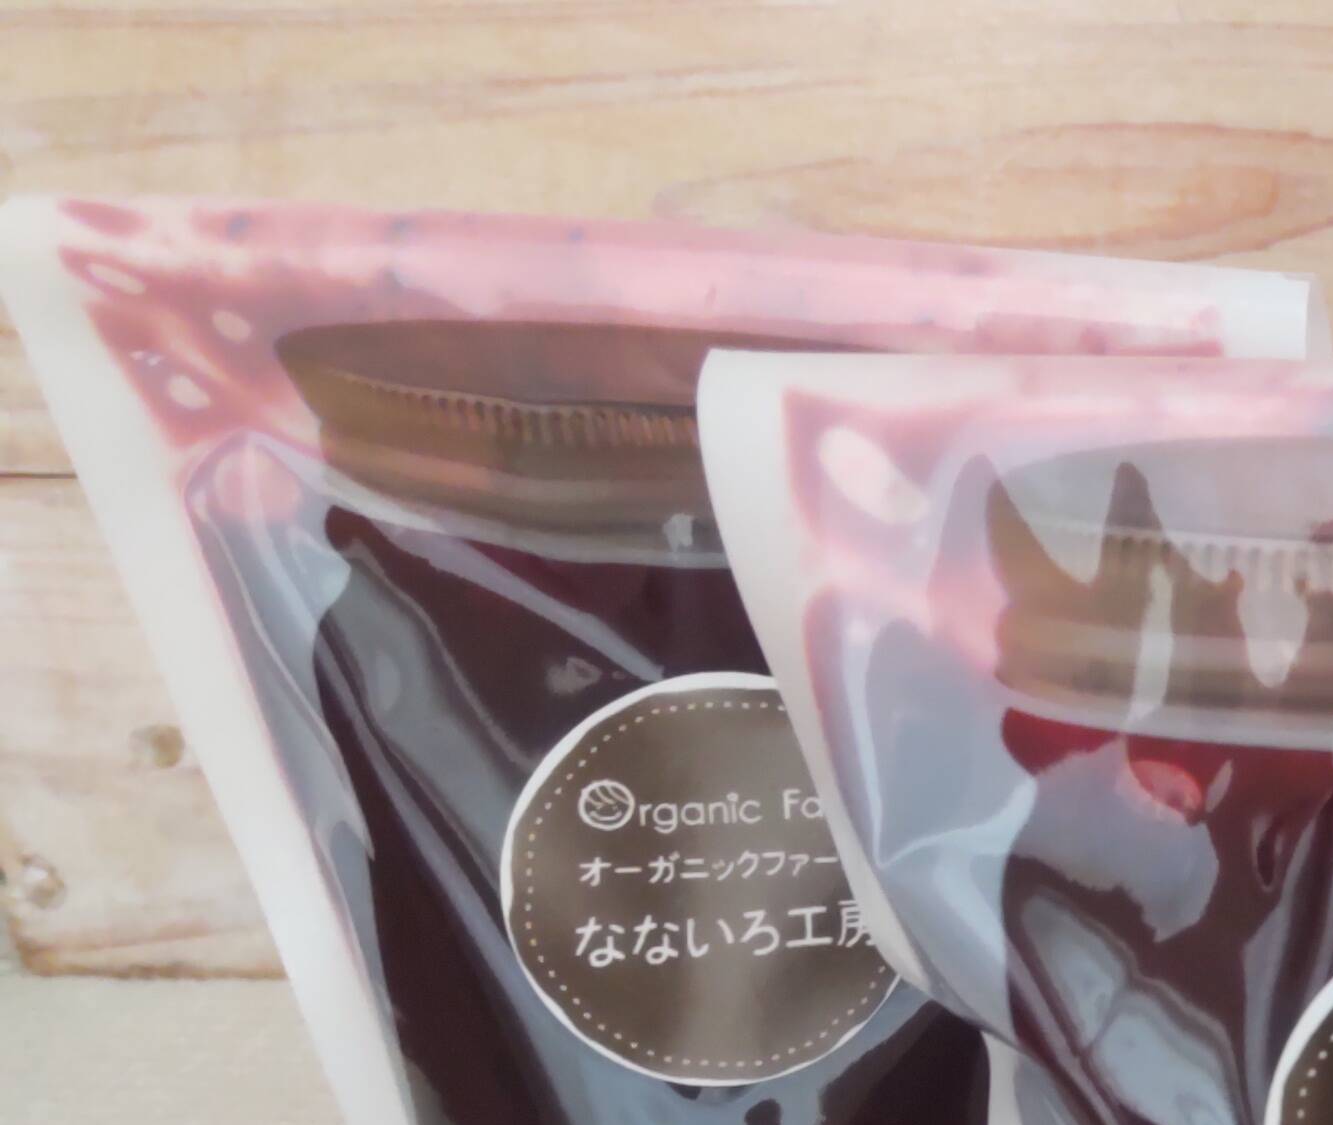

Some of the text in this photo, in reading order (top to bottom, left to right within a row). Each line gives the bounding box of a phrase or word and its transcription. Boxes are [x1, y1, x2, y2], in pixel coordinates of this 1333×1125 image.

[578, 780, 826, 833] Organic Fa
[579, 851, 840, 887] オーガニックファー
